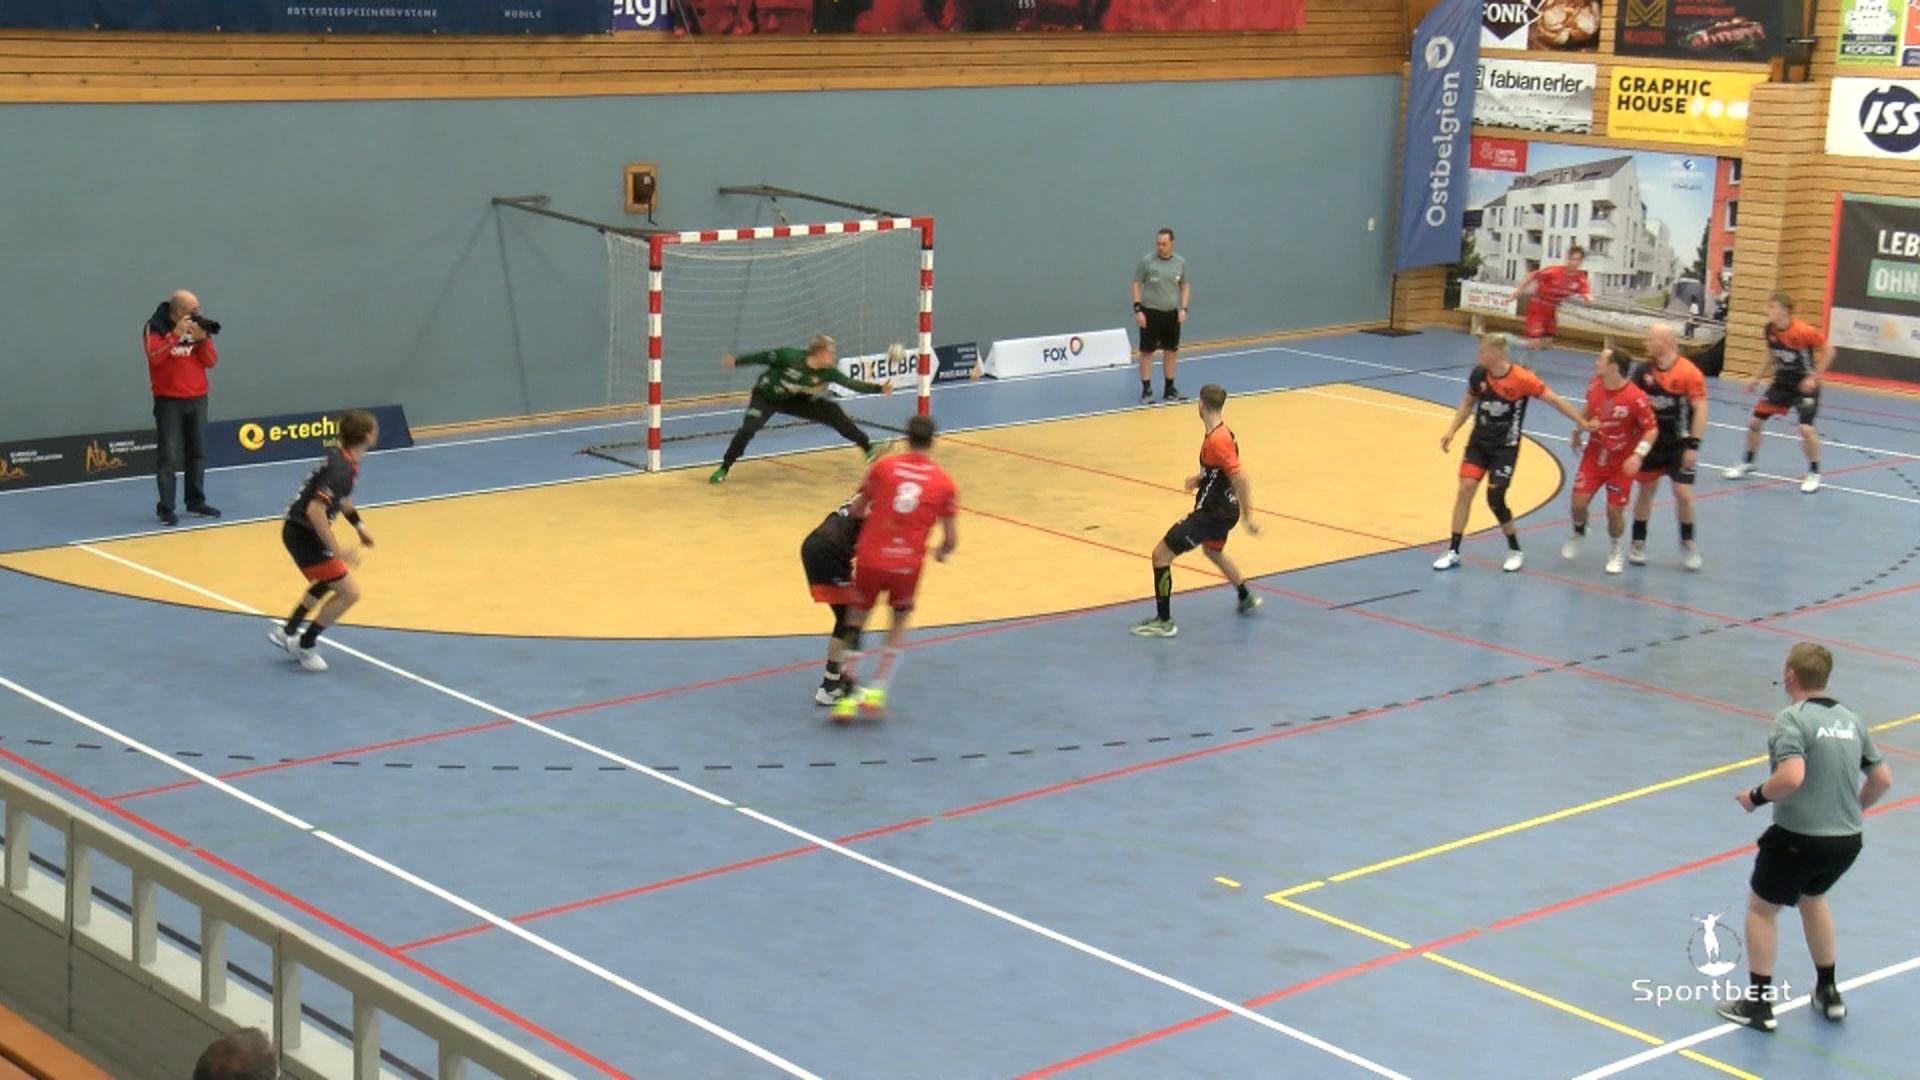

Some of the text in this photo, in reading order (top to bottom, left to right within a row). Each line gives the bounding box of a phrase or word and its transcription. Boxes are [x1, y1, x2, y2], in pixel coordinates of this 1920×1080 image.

[1490, 69, 1584, 93] fabian erler
[1618, 76, 1712, 97] GRAPHIC
[1616, 96, 1687, 115] HOUSE
[1425, 71, 1461, 227] Ostbelgien
[1877, 229, 1920, 258] LEB
[1875, 268, 1920, 295] OHN
[850, 354, 920, 381] PIXELBA
[1043, 346, 1068, 363] FOX
[891, 481, 923, 514] 8
